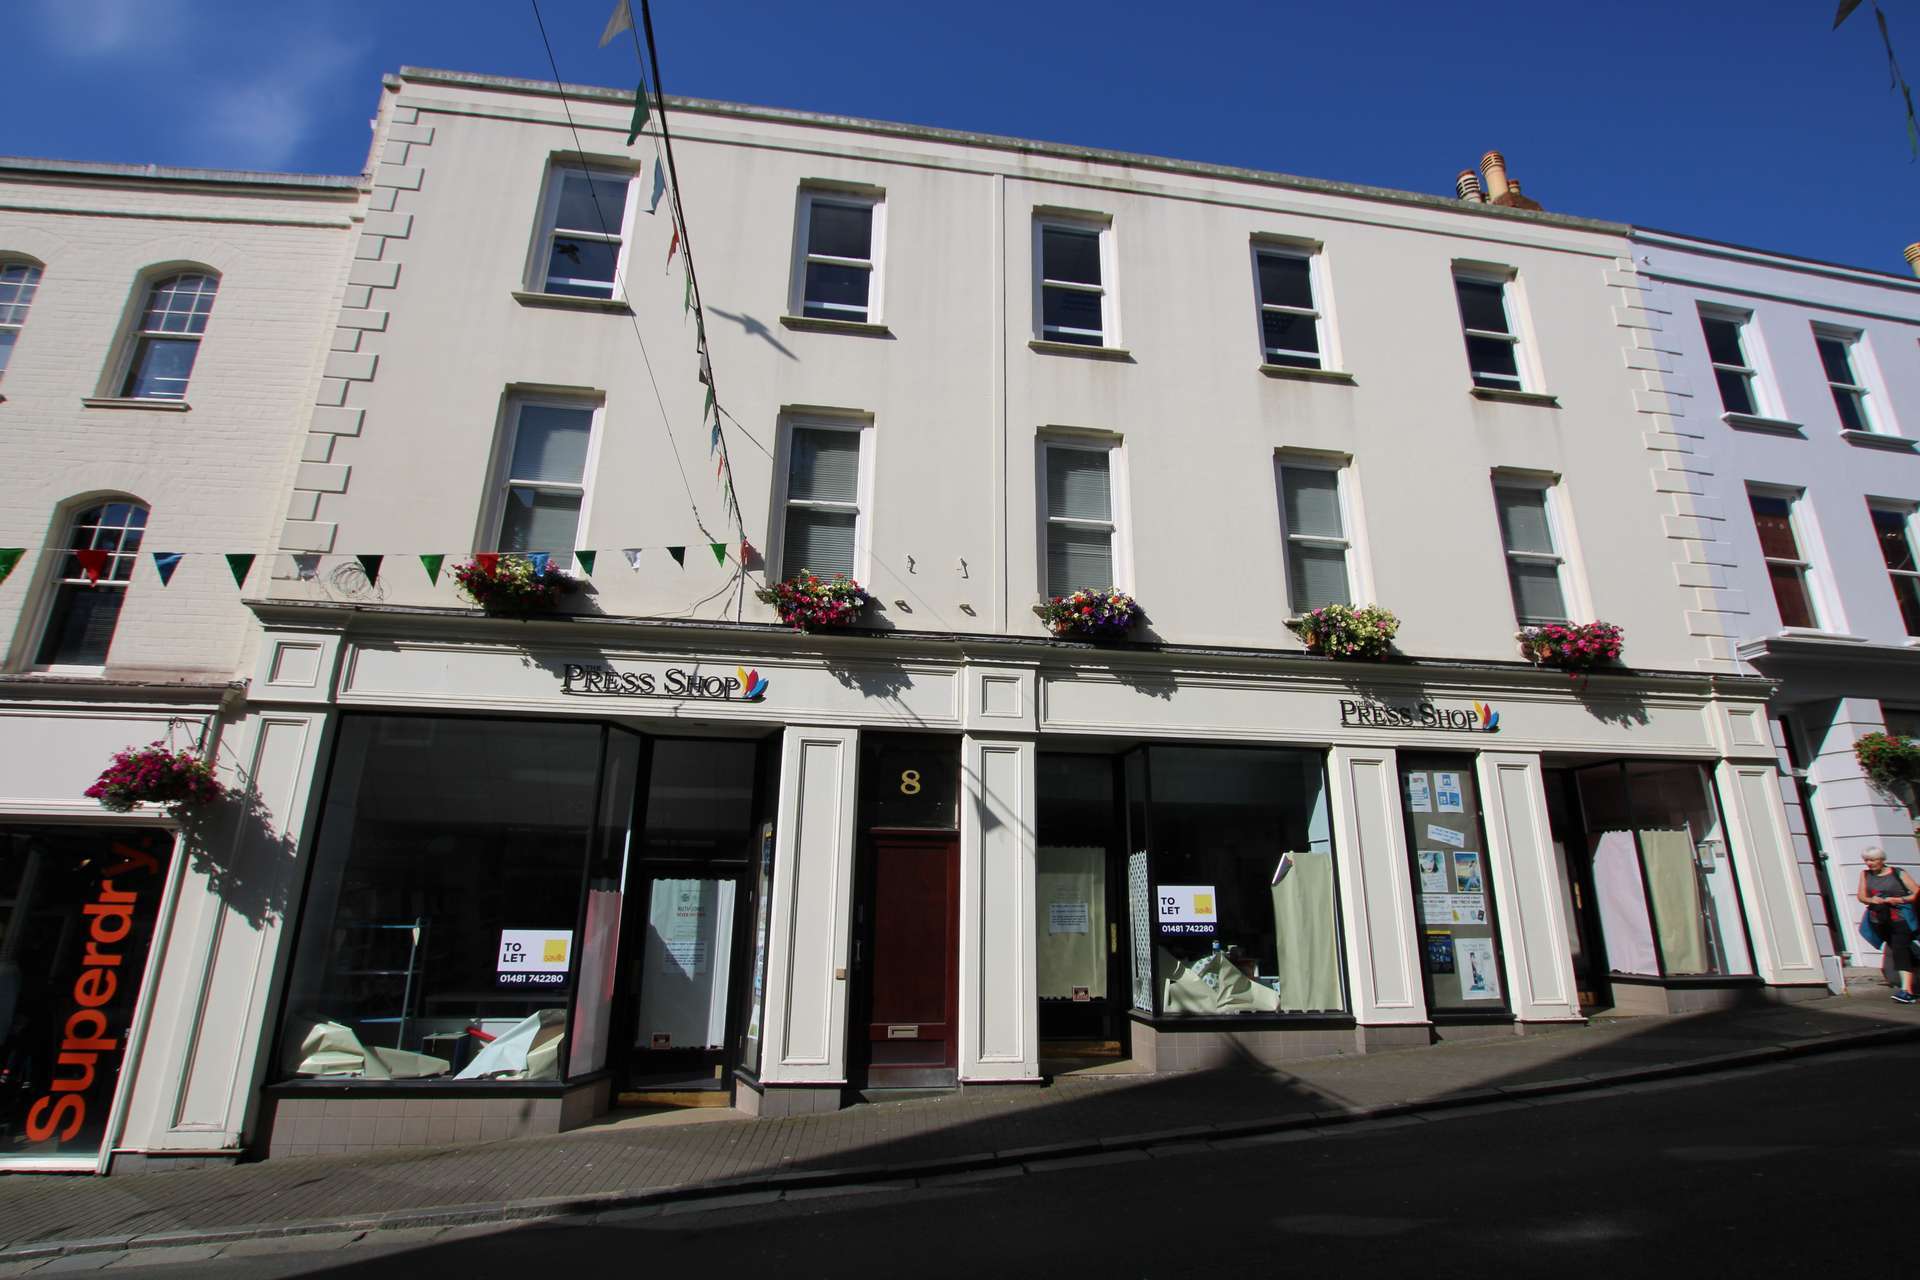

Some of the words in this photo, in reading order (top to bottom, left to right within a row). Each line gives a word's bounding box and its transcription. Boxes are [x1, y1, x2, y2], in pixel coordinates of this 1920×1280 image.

[562, 663, 656, 694] PRESS
[664, 668, 741, 700] SHOP
[1338, 699, 1414, 727] PRESS
[1418, 702, 1479, 730] SHOP
[901, 770, 920, 794] 8
[1160, 897, 1175, 905] TO
[1161, 906, 1180, 915] LET
[1162, 924, 1184, 932] 01481
[1185, 924, 1214, 932] 742280
[504, 942, 522, 952] TO
[502, 953, 526, 963] LET
[500, 974, 526, 983] 01481
[528, 974, 564, 983] 742280
